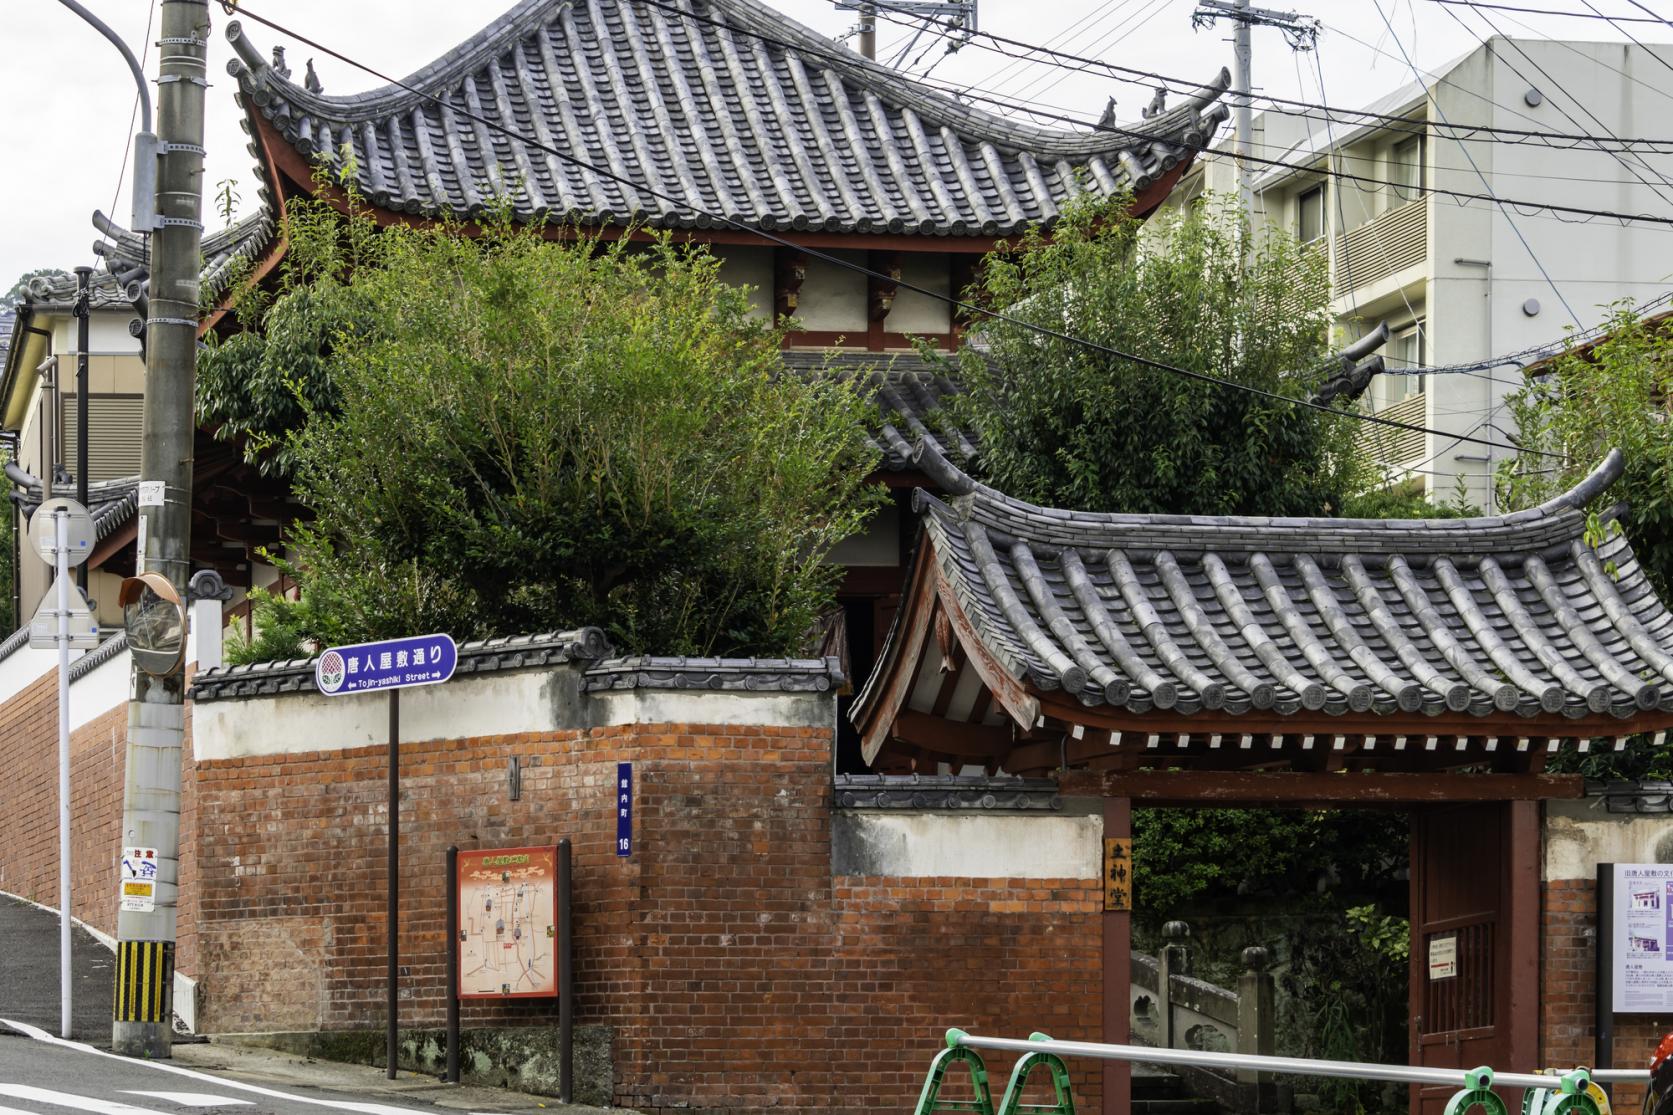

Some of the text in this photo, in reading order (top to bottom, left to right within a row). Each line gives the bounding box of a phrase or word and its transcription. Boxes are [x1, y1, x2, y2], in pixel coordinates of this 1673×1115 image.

[347, 645, 442, 674] 唐人屋敷通り
[358, 671, 431, 689] Tojin-yashiki Street
[619, 778, 629, 850] 館内町 16
[134, 849, 154, 859] 注意
